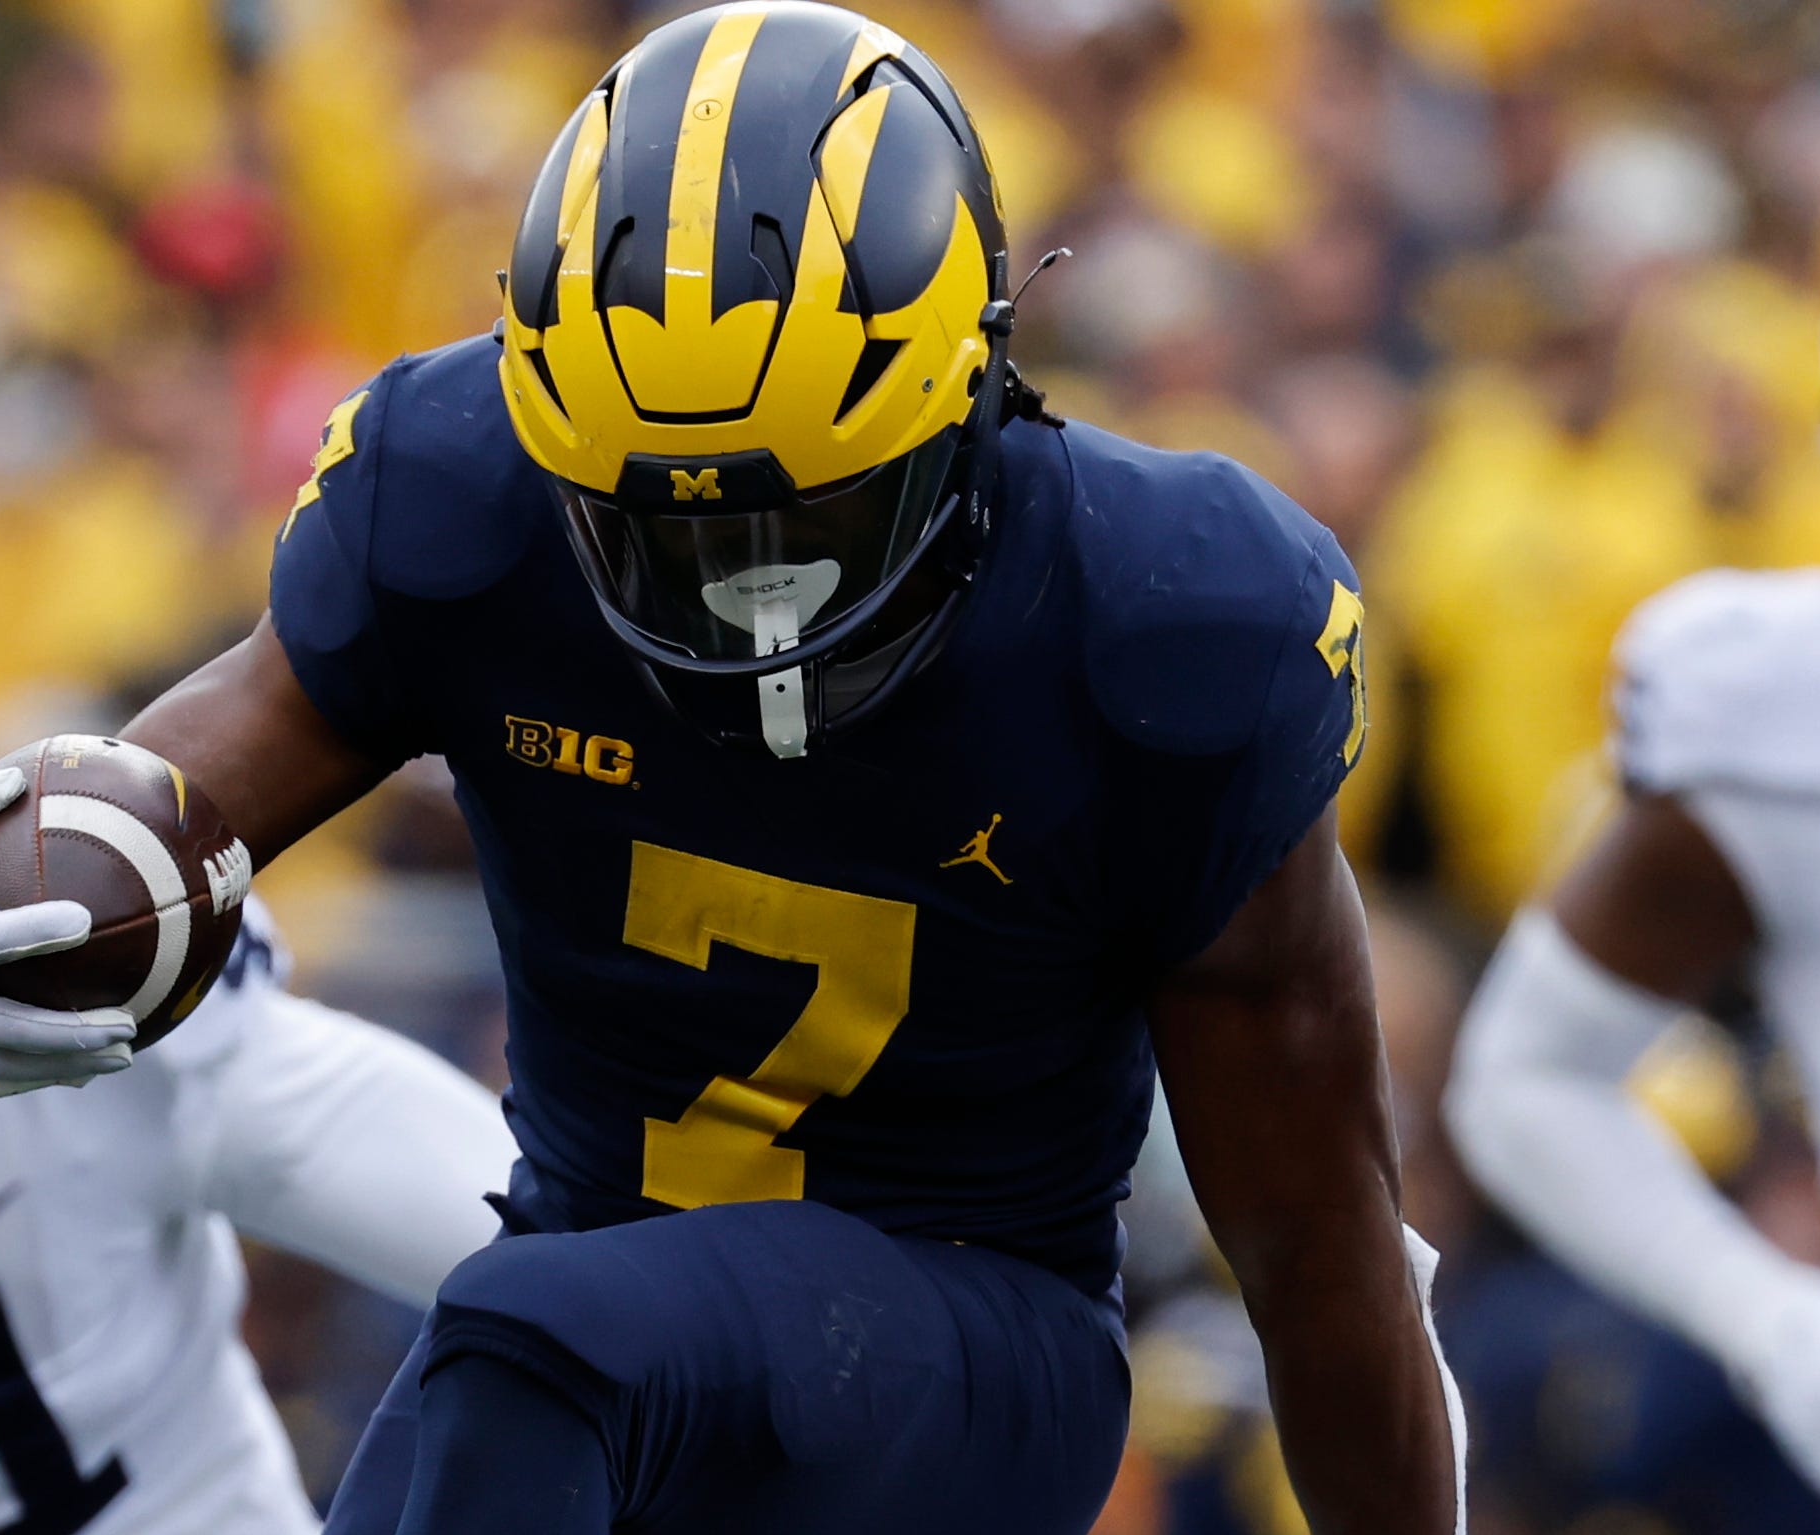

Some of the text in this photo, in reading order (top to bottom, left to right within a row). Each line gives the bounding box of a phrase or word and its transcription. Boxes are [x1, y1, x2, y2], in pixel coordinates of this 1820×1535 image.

[670, 468, 722, 501] M
[736, 576, 797, 596] SHOCK
[622, 839, 918, 1211] 7
